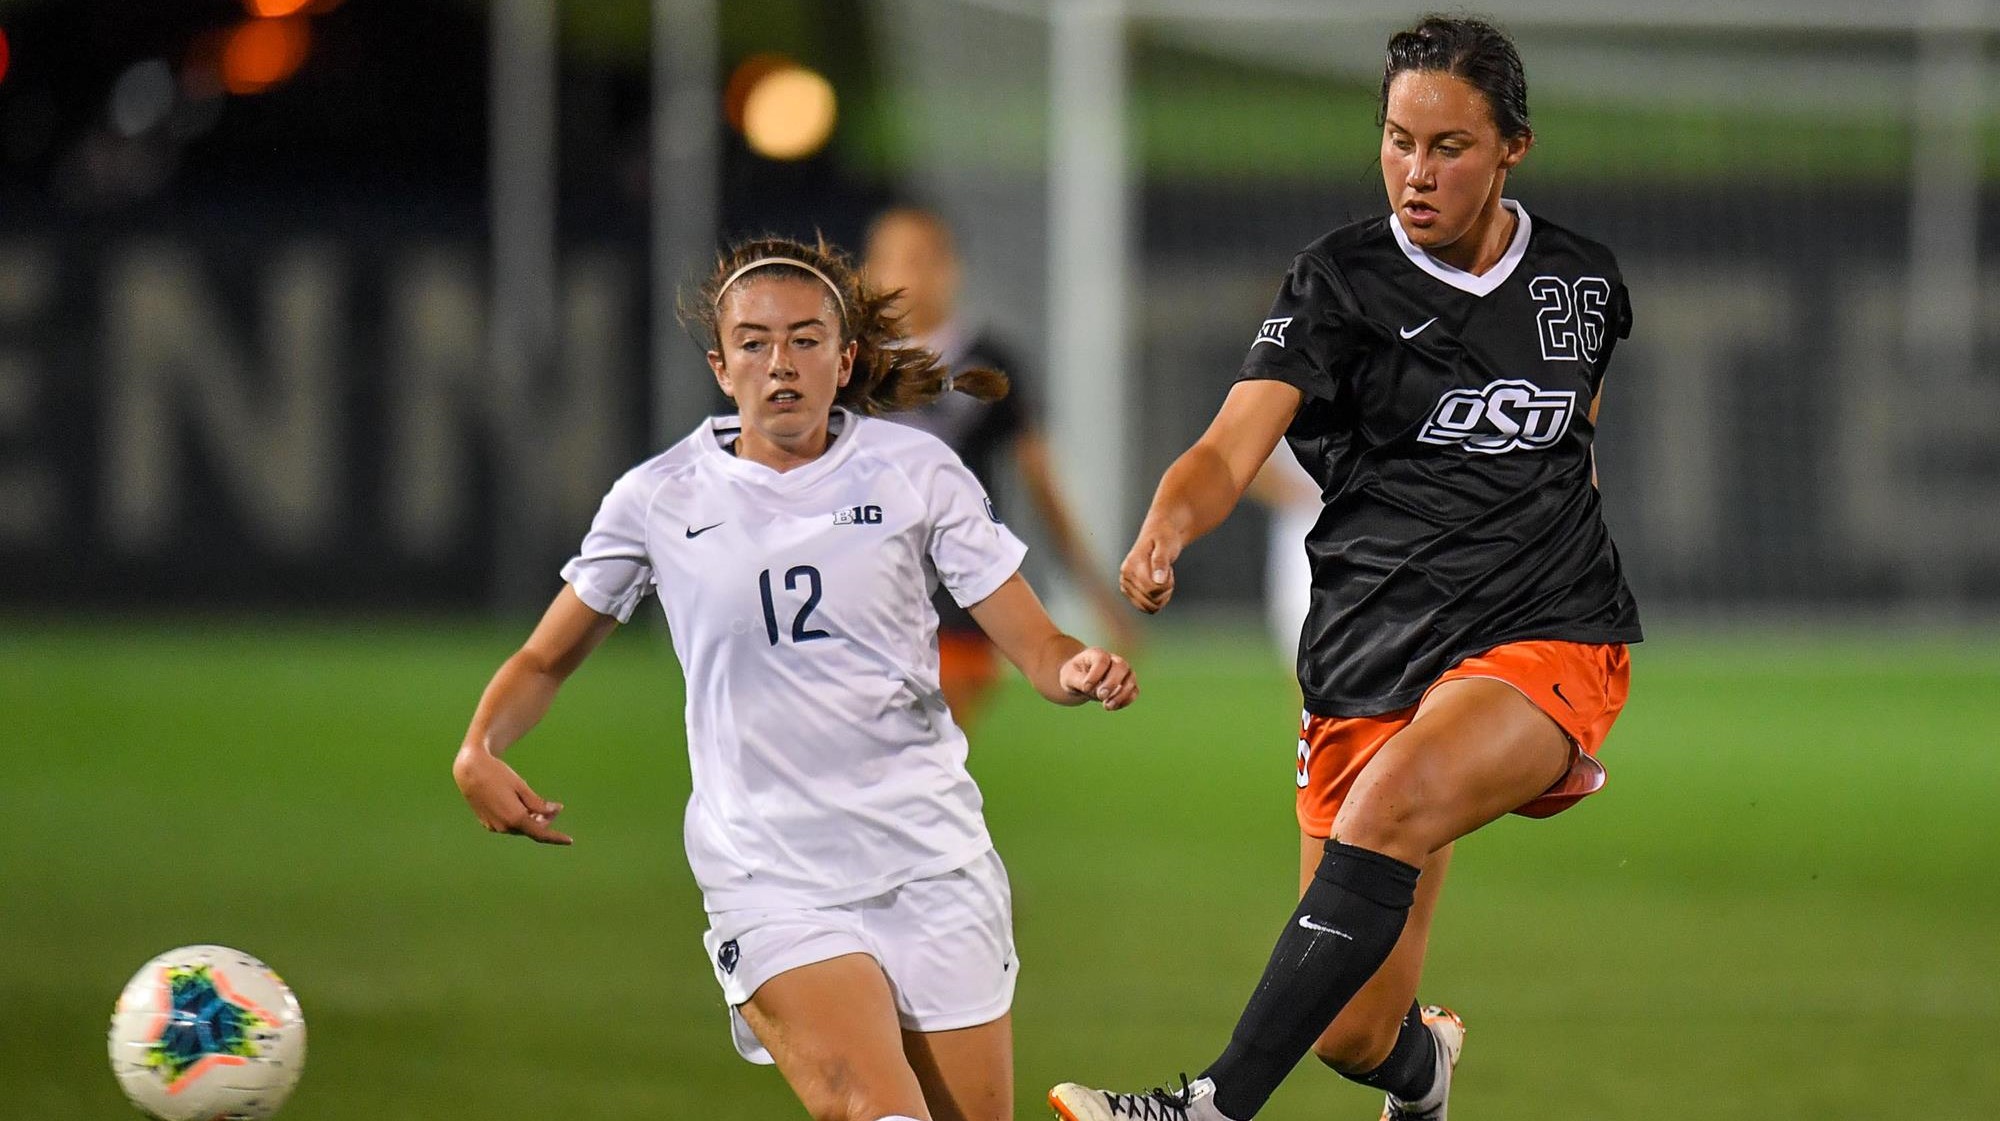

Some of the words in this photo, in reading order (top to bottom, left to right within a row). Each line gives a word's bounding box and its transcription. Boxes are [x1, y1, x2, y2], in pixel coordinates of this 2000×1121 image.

[1528, 275, 1611, 363] 26
[1416, 379, 1576, 454] OSU
[759, 565, 831, 646] 12
